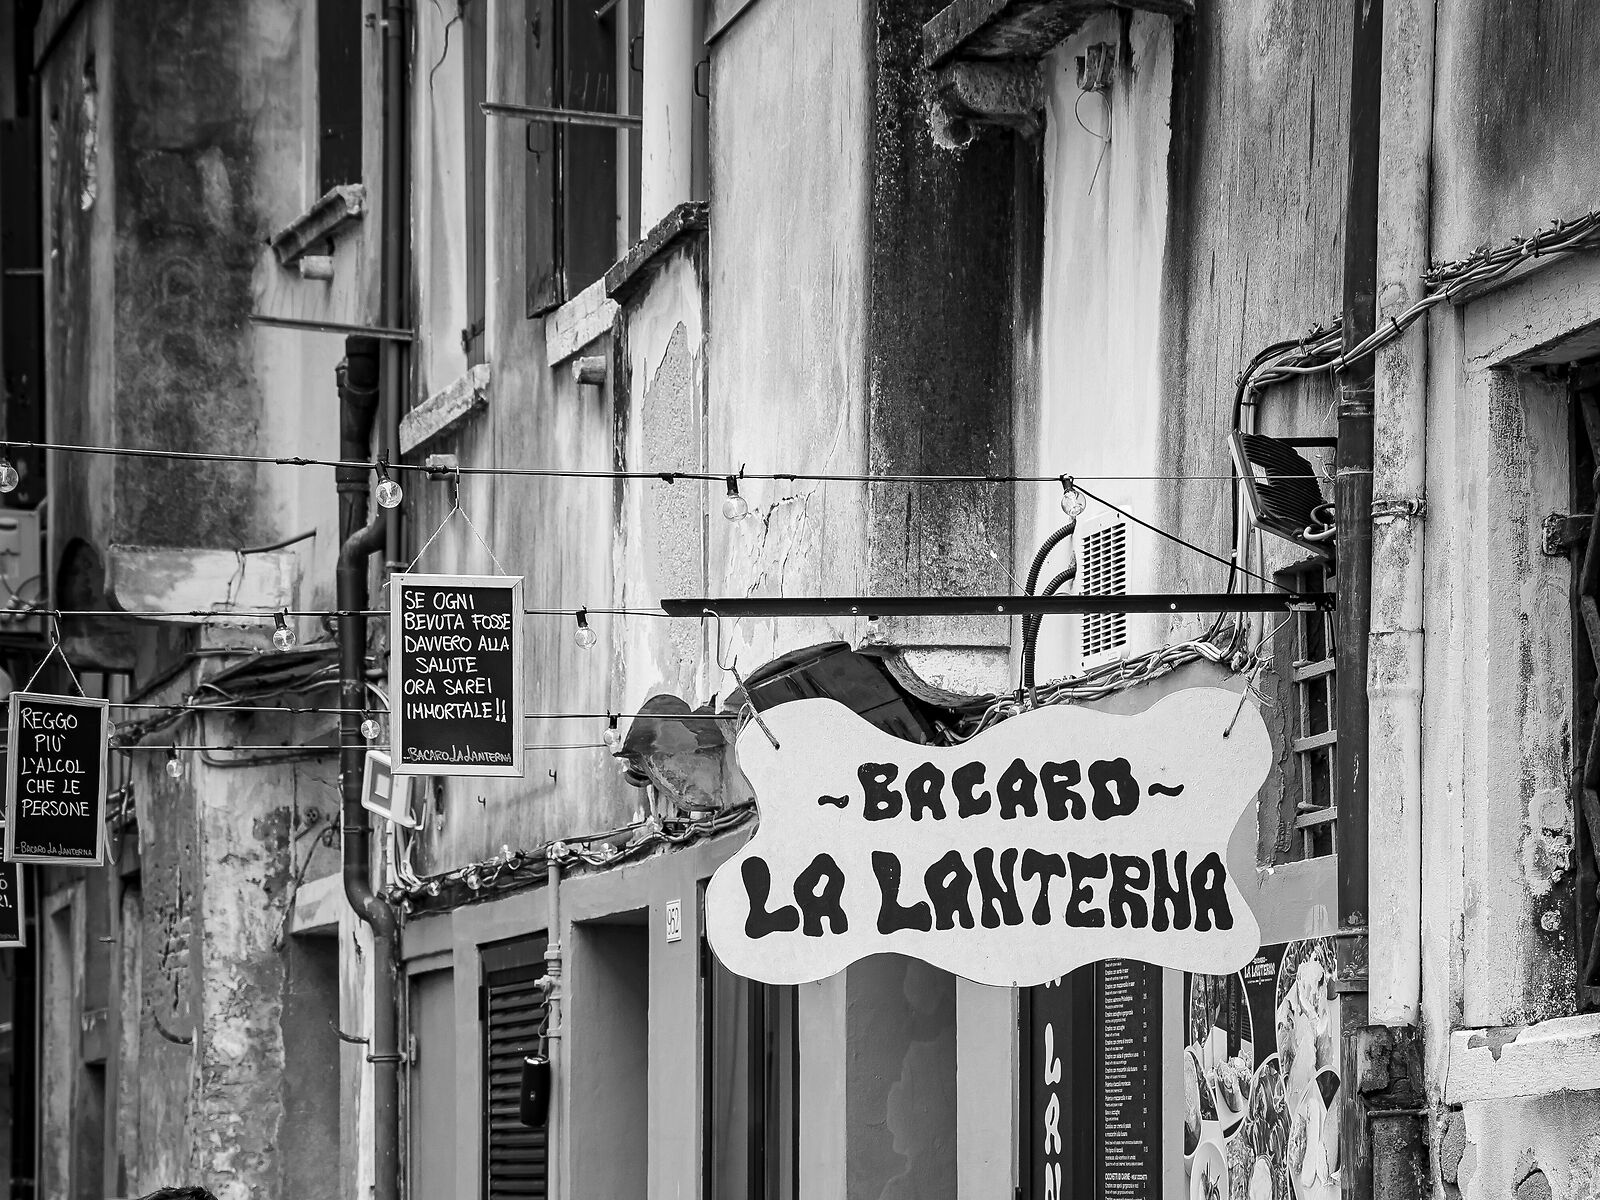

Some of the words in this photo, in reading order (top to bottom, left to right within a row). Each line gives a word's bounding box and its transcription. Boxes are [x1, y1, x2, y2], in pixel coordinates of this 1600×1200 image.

[404, 590, 425, 610] SE
[433, 592, 475, 610] OGNI
[404, 612, 465, 631] BEVUTA
[471, 613, 511, 630] FOSSE
[404, 635, 472, 653] DAVVERO
[478, 635, 510, 652] ALLA
[415, 657, 478, 674] SALUTE
[404, 679, 436, 695] ORA
[443, 677, 492, 696] SAREI
[21, 708, 78, 730] REGGO
[406, 697, 507, 723] IMMORTALE!!
[26, 779, 55, 794] CHE
[62, 779, 81, 795] LE
[21, 799, 90, 817] PERSONE
[740, 852, 849, 939] LA
[871, 847, 1234, 936] LANTERNA
